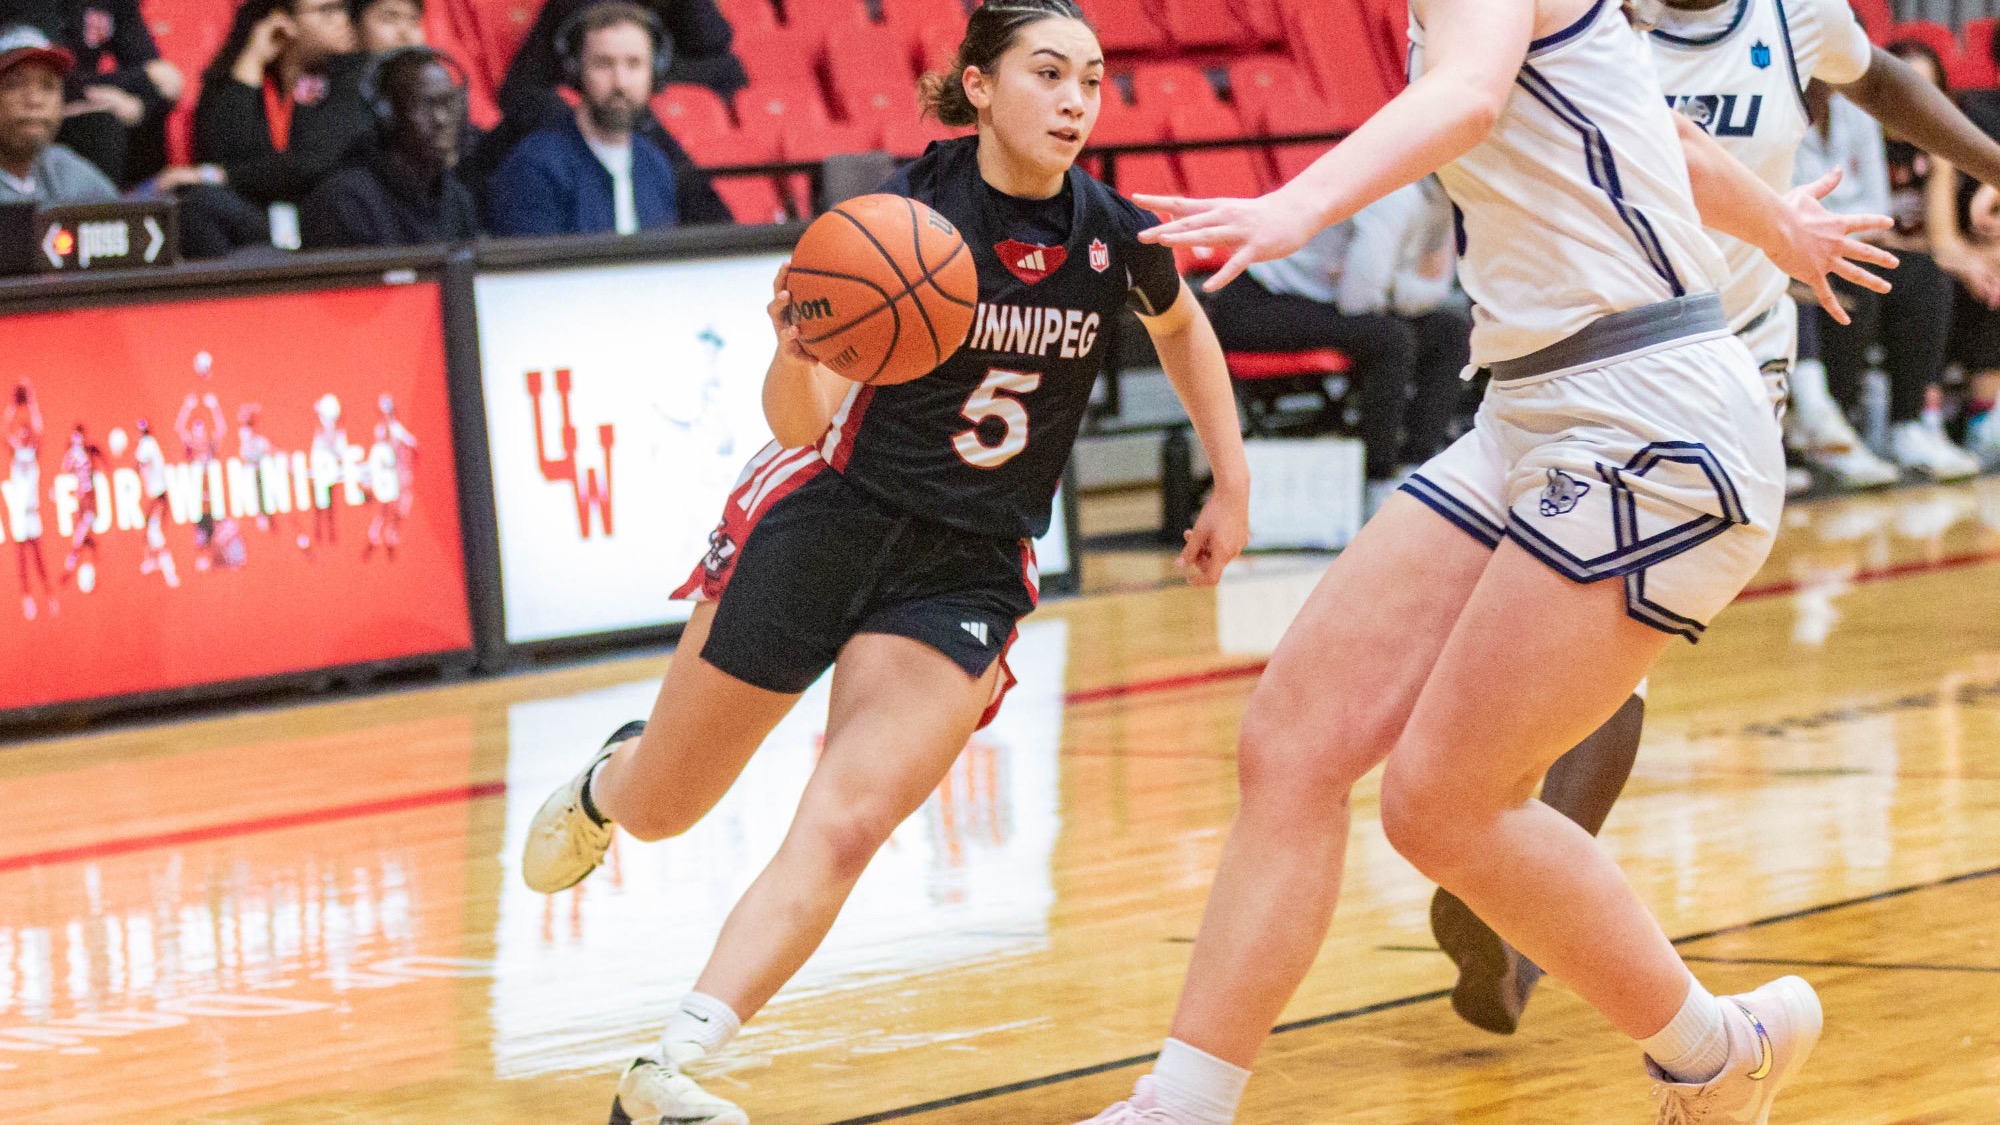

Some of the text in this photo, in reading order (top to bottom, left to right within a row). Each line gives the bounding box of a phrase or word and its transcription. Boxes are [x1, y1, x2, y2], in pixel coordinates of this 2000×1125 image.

[969, 302, 1100, 359] INNIPEG
[951, 366, 1043, 470] 5
[163, 440, 400, 525] WINNIPEG
